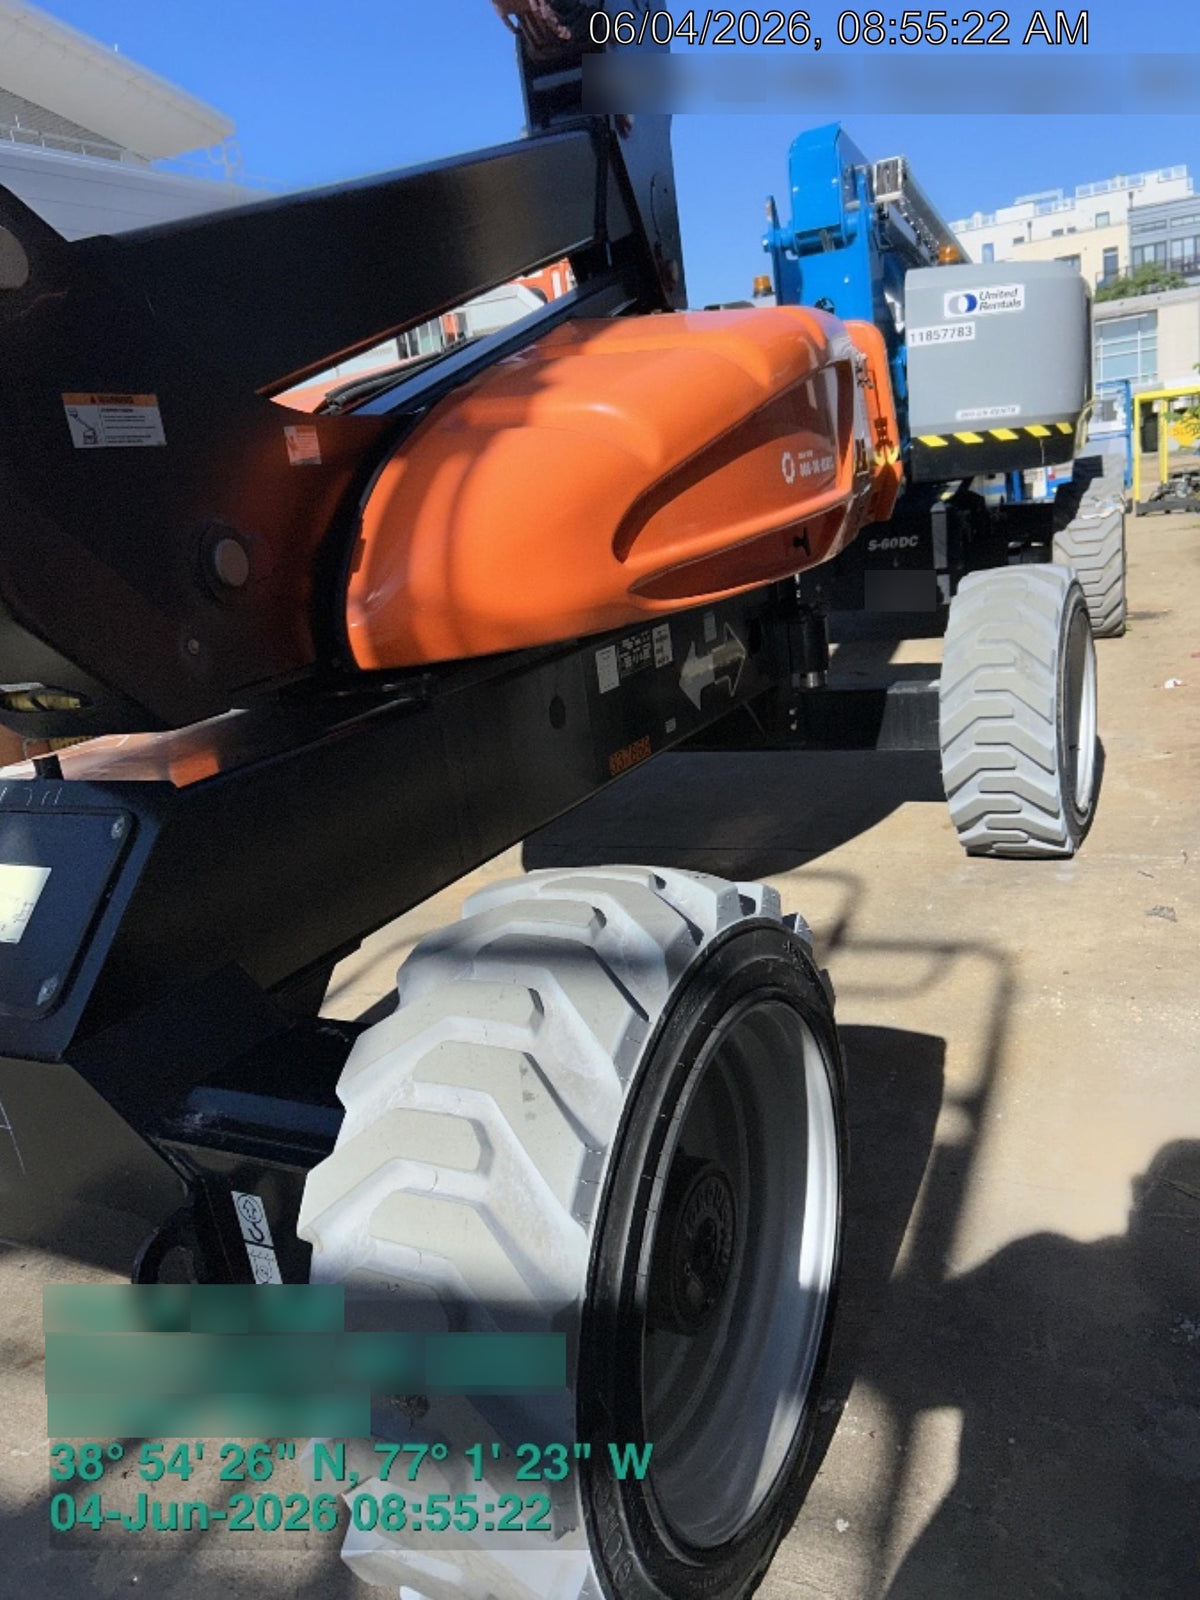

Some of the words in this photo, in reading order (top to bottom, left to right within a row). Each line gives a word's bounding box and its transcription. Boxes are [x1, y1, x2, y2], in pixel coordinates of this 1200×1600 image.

[980, 287, 1018, 301] United
[979, 299, 1021, 311] Rentals
[910, 325, 972, 342] 11857783
